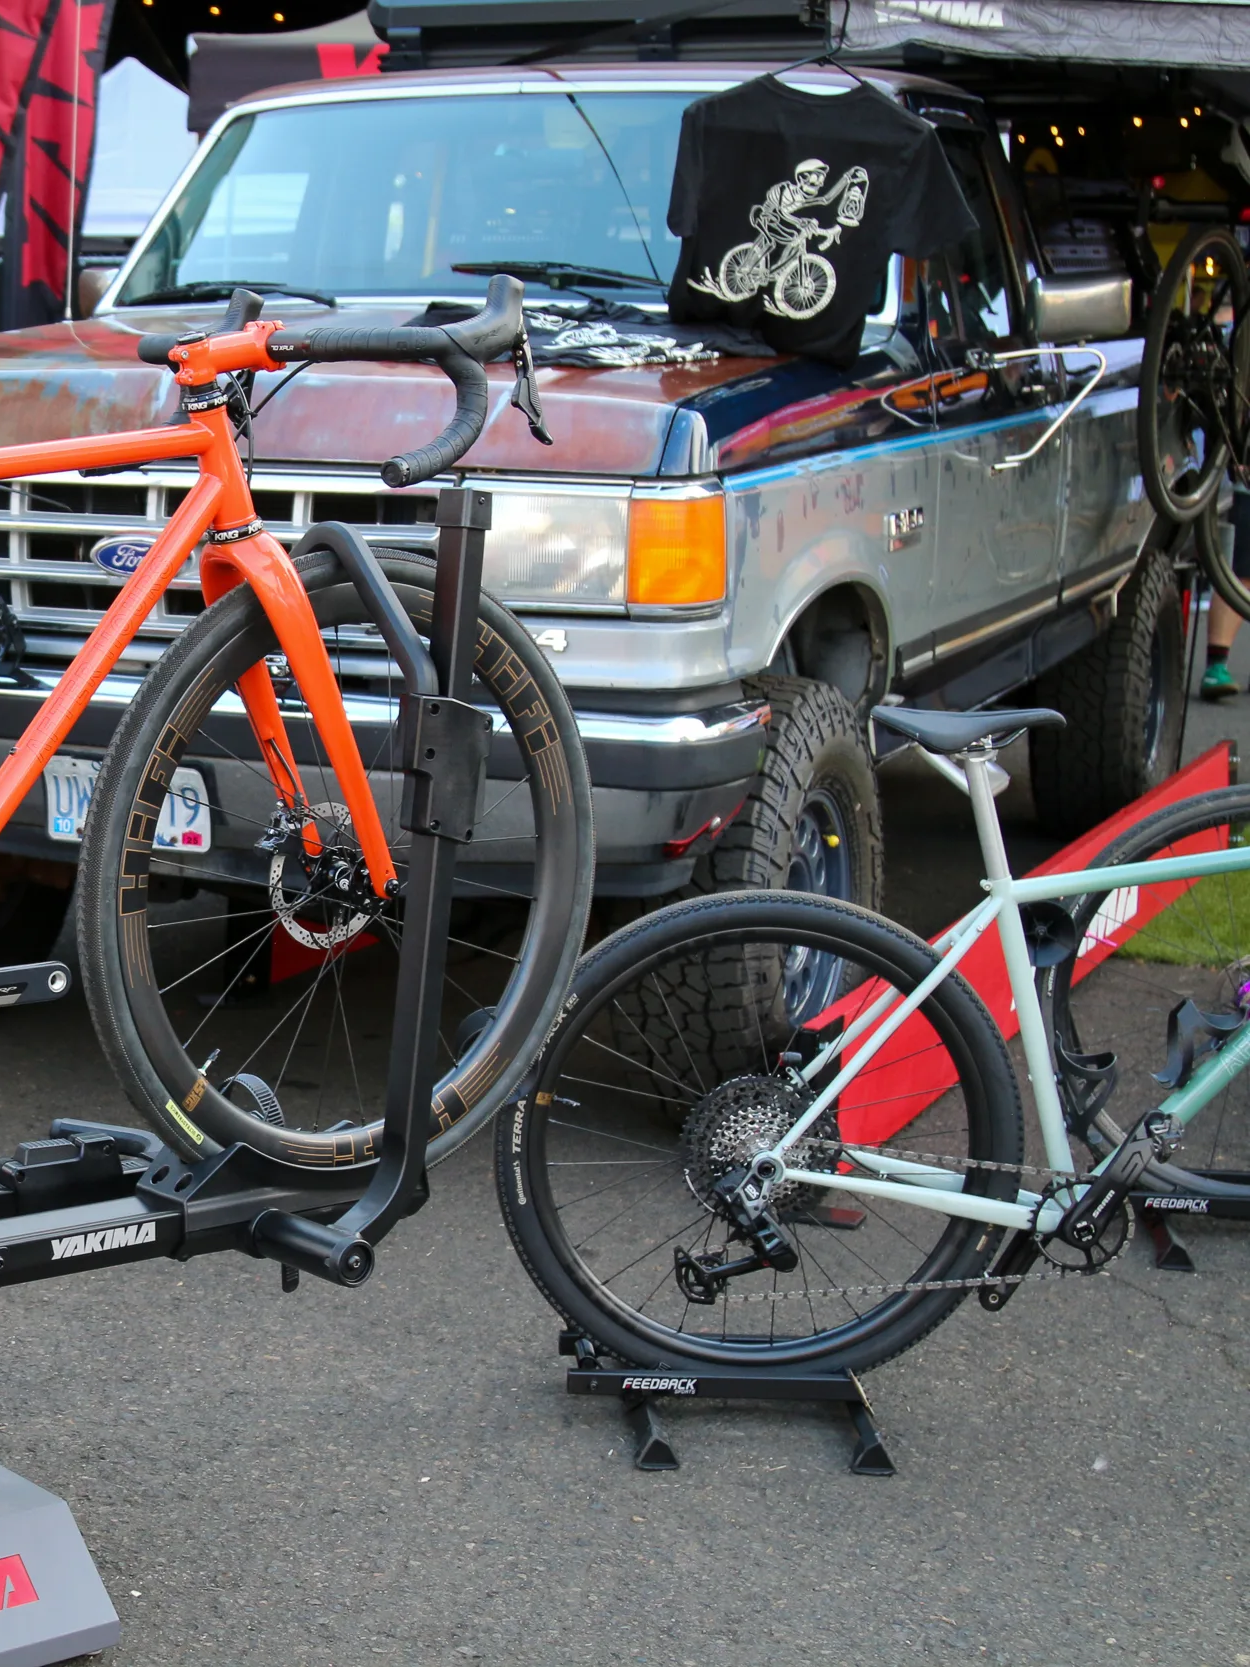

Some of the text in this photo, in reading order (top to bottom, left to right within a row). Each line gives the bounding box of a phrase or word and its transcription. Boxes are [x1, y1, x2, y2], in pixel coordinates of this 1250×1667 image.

[187, 401, 208, 411] KING
[214, 530, 239, 541] KING
[168, 786, 201, 828] 19
[57, 819, 71, 832] 10
[186, 836, 199, 845] 25
[512, 1100, 528, 1155] TERRA
[512, 1166, 527, 1206] Continental
[1092, 1189, 1116, 1219] SRAM
[1144, 1197, 1210, 1210] FEEDBACK
[51, 1221, 156, 1260] YAKIMA
[622, 1378, 697, 1390] FEEDBACK
